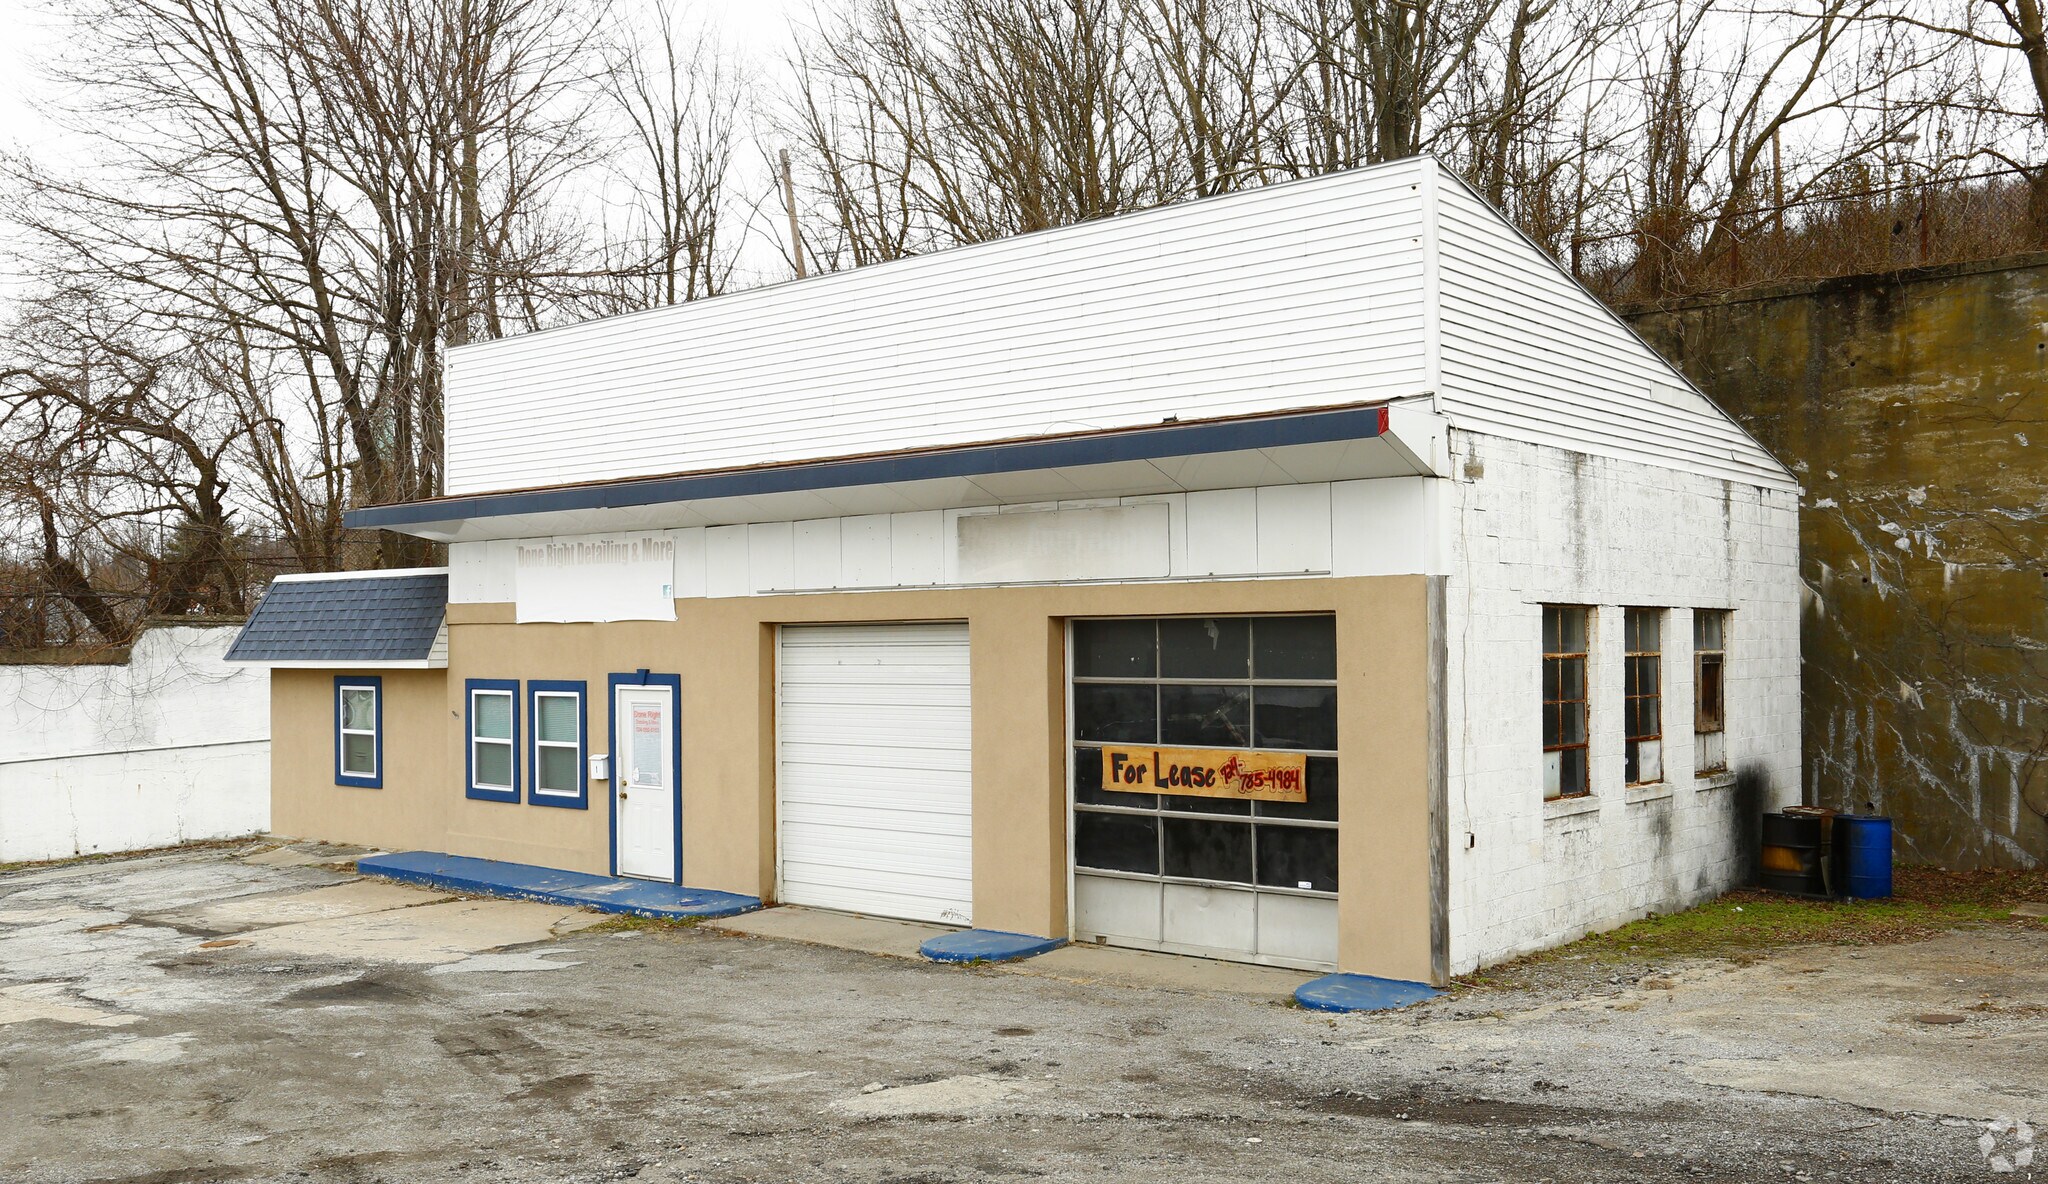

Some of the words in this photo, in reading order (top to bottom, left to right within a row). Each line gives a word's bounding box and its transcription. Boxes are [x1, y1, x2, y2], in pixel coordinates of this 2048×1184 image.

[518, 545, 544, 568] Done
[547, 543, 575, 568] Right
[577, 539, 629, 566] Detailing
[632, 542, 639, 562] &
[642, 537, 673, 562] More
[1111, 752, 1147, 784] For
[1153, 751, 1216, 789] Lease
[1239, 767, 1300, 792] 785-4984
